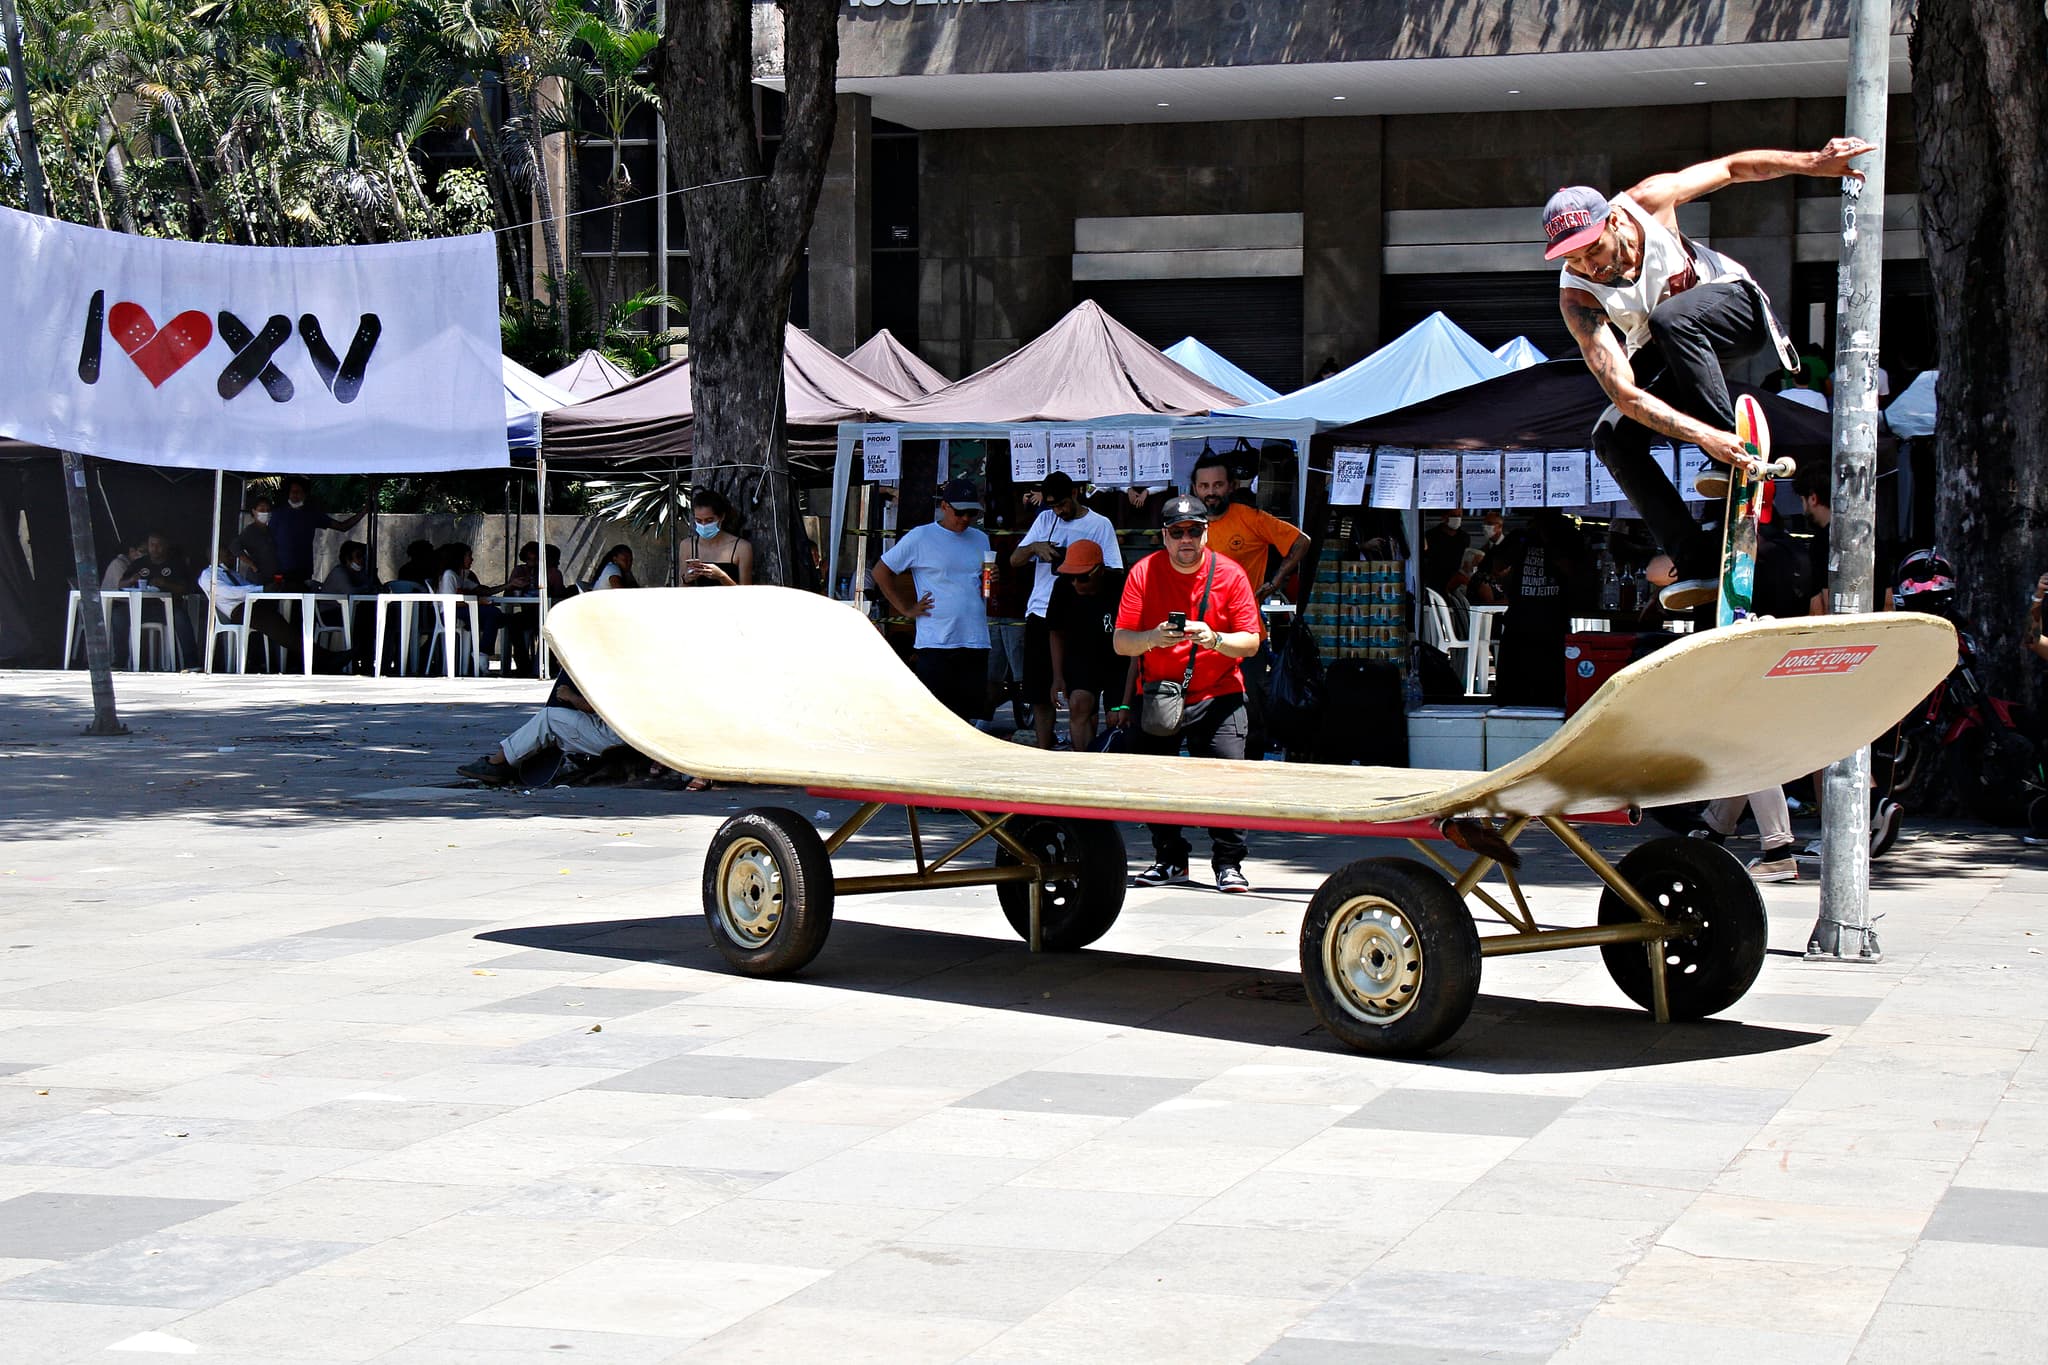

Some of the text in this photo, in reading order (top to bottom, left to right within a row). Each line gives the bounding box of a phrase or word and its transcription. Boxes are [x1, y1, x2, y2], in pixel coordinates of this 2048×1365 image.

[216, 311, 382, 404] XV
[1523, 566, 1544, 576] QUE O
[1521, 586, 1560, 596] TEM JEITO?
[1776, 652, 1868, 668] JORGE CUPIM
